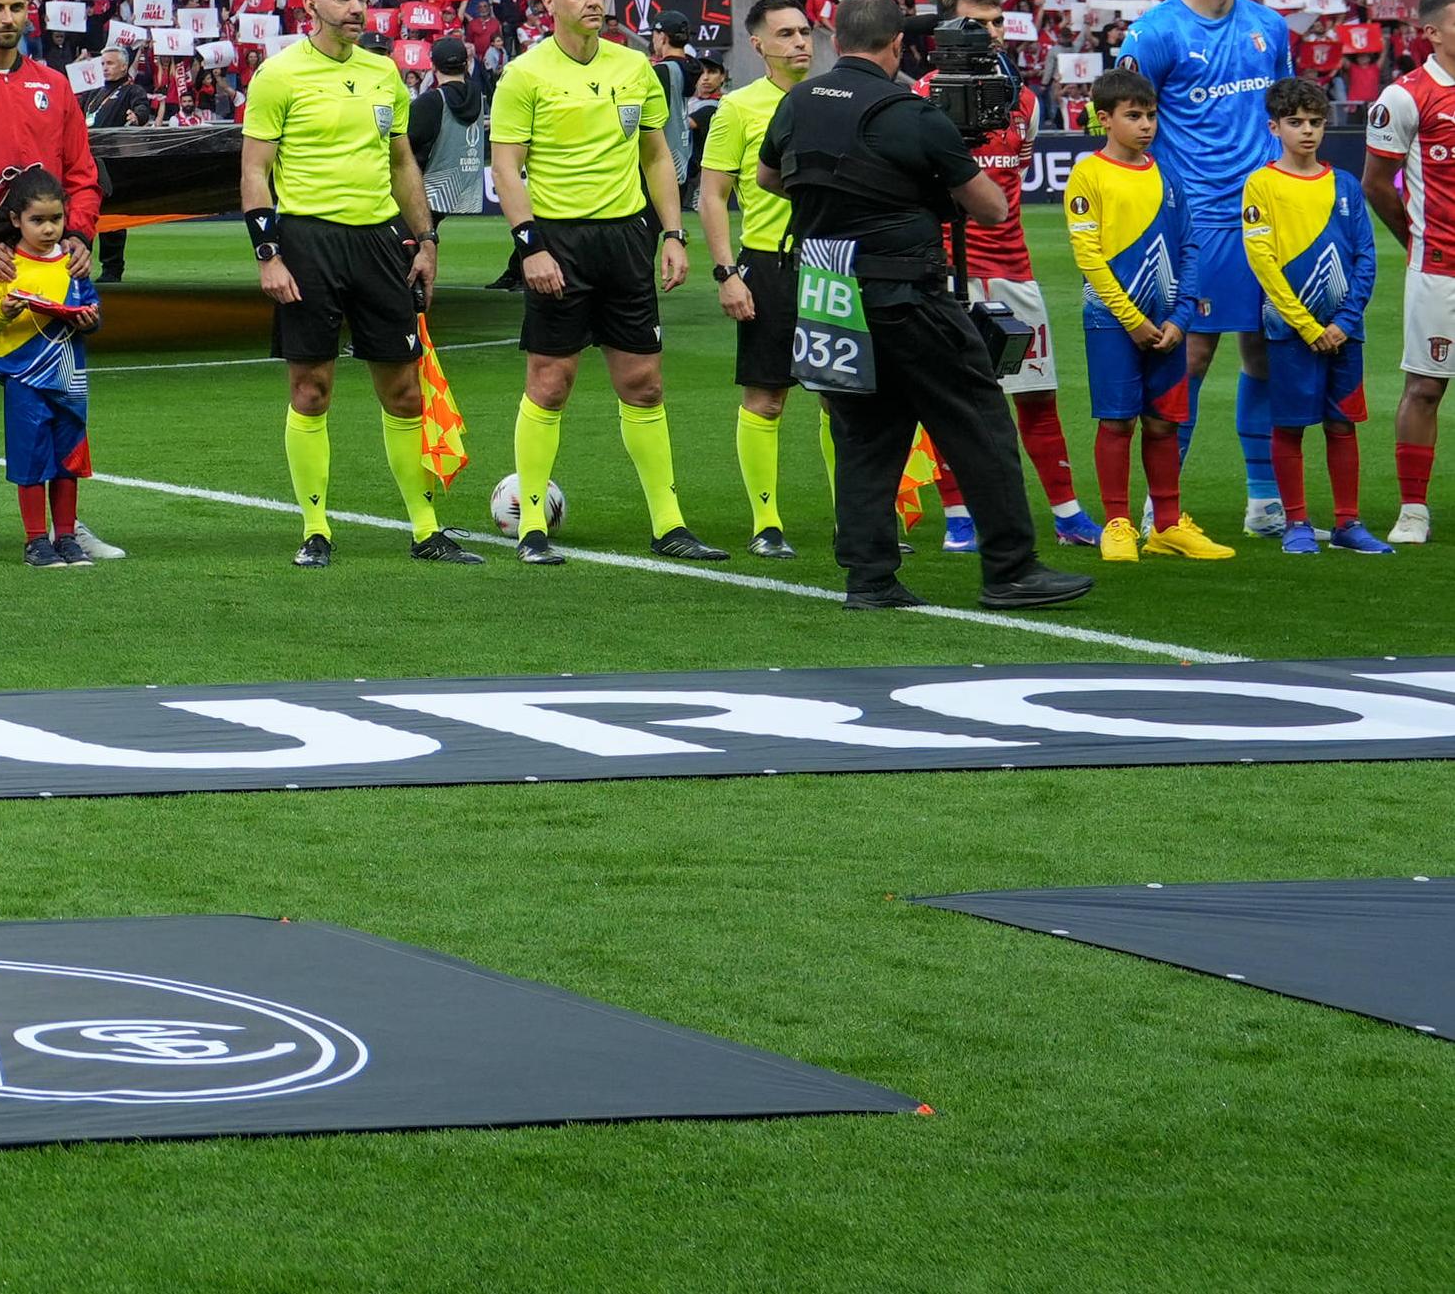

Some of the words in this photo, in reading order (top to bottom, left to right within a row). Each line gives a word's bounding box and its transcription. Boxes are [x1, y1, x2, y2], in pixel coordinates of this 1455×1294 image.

[697, 24, 720, 41] A7
[800, 274, 853, 318] HB
[793, 327, 859, 374] 032
